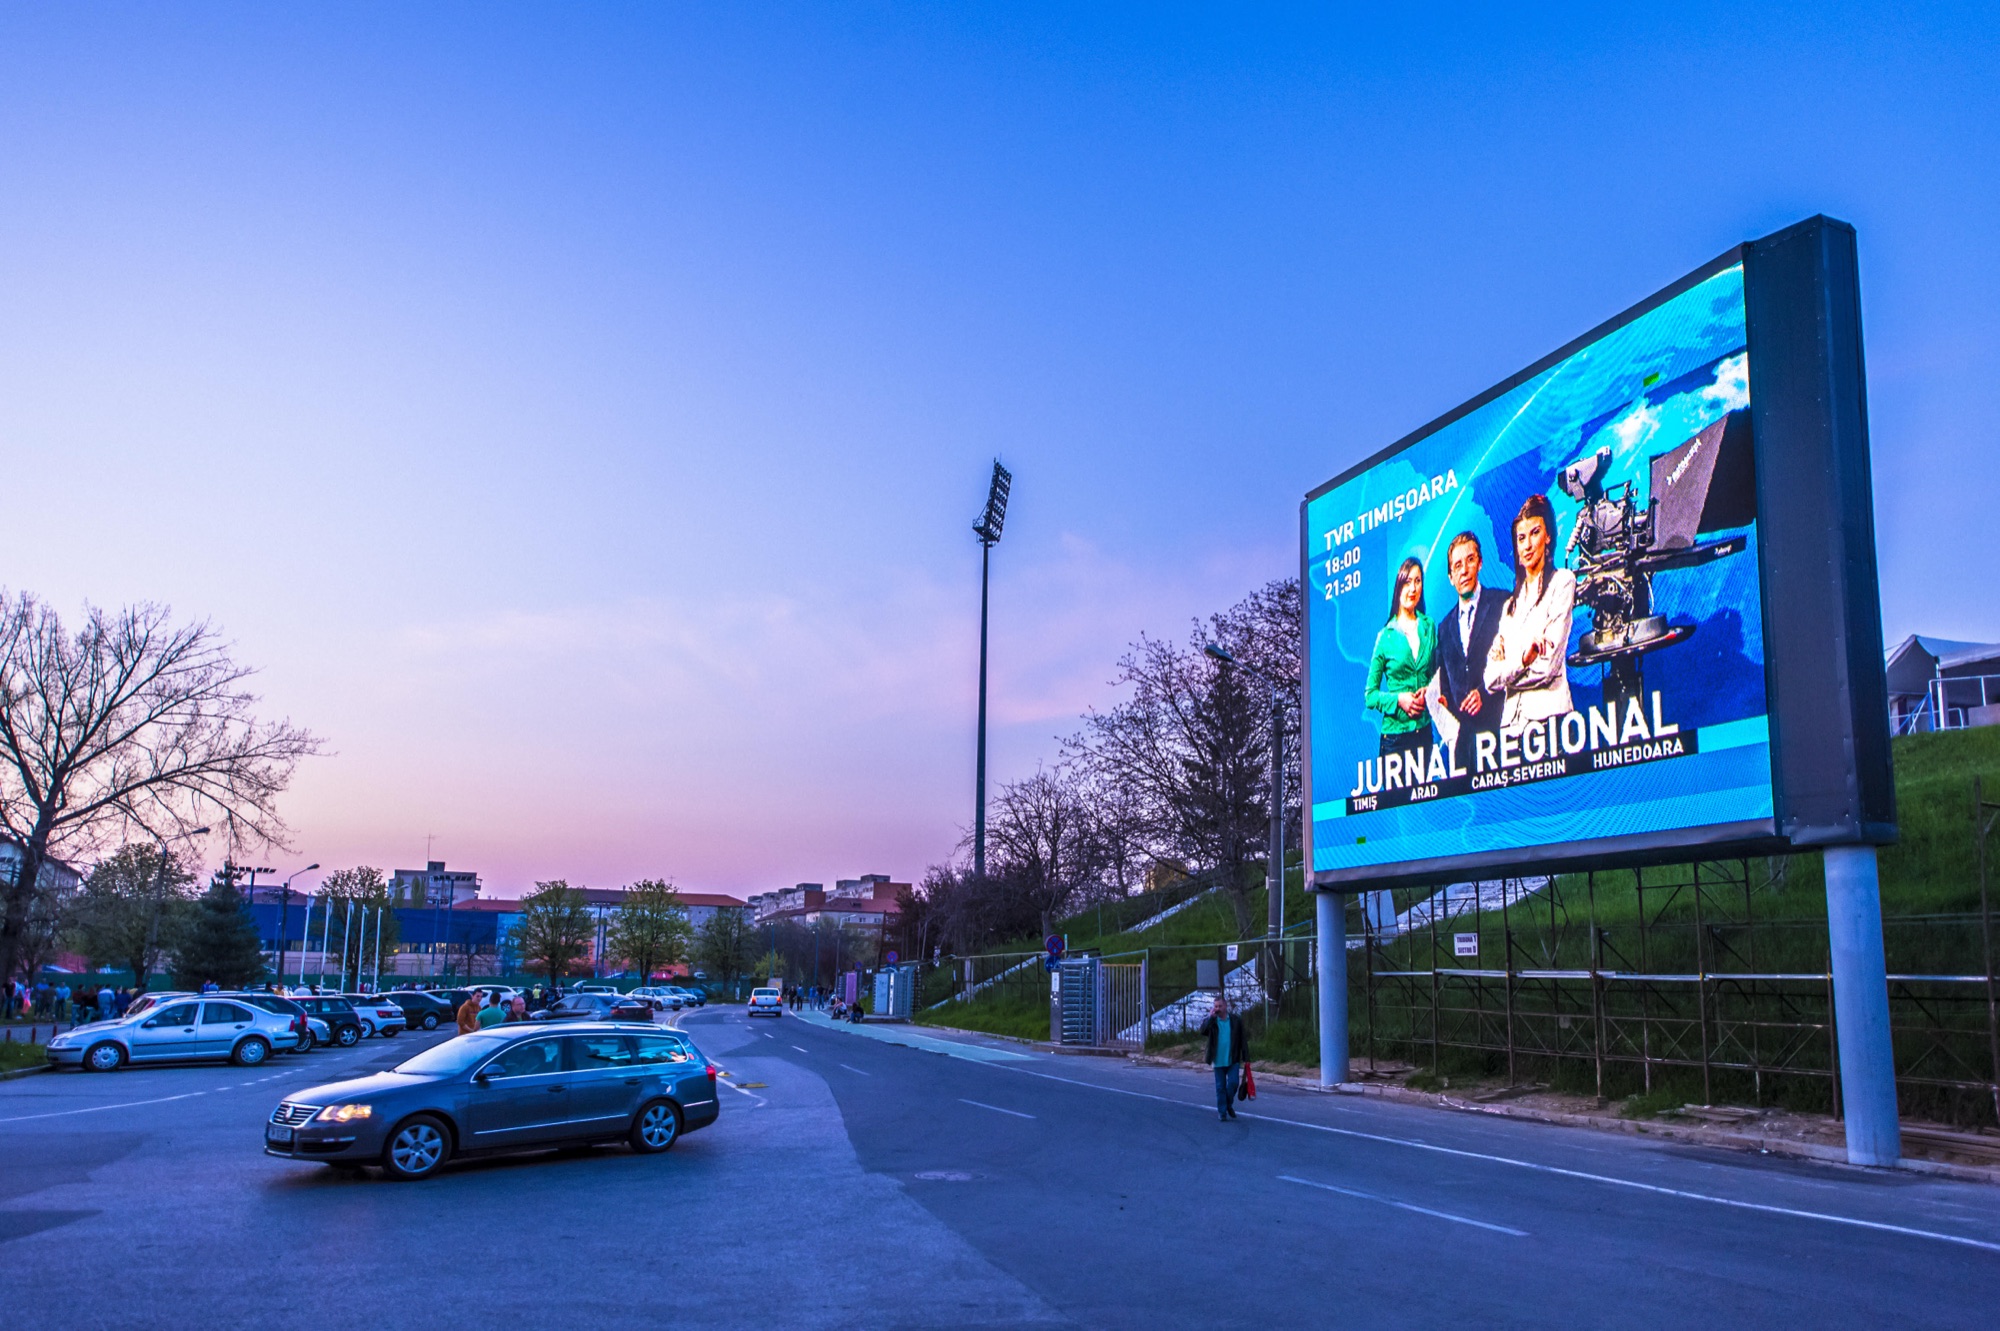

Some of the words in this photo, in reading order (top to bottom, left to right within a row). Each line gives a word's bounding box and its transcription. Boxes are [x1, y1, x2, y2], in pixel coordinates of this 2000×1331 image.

[1323, 520, 1355, 551] TVR
[1357, 468, 1459, 523] TIMIȘOARA
[1324, 546, 1361, 577] 18:00
[1324, 570, 1361, 601] 21:30
[1350, 738, 1468, 797] JURNAL
[1475, 690, 1679, 773] REGIONAL
[1352, 795, 1378, 811] TIMIȘ
[1410, 784, 1438, 801] ARAD
[1471, 759, 1566, 789] CARAȘ-SEVERIN
[1593, 738, 1684, 768] HUNEDOARA
